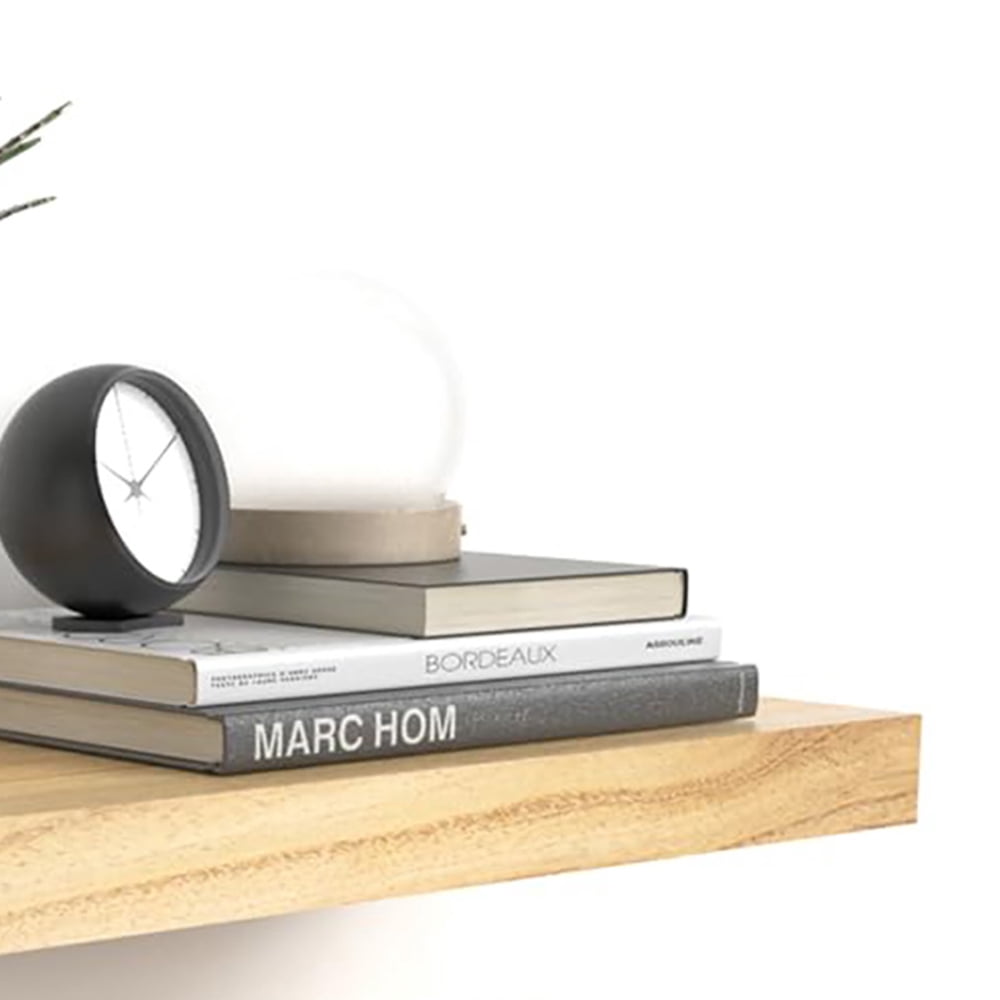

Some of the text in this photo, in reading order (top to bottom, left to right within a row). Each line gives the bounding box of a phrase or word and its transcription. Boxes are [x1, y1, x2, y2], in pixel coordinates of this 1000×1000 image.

[425, 643, 557, 674] BORDEAUX
[253, 704, 457, 760] MARC HOM
